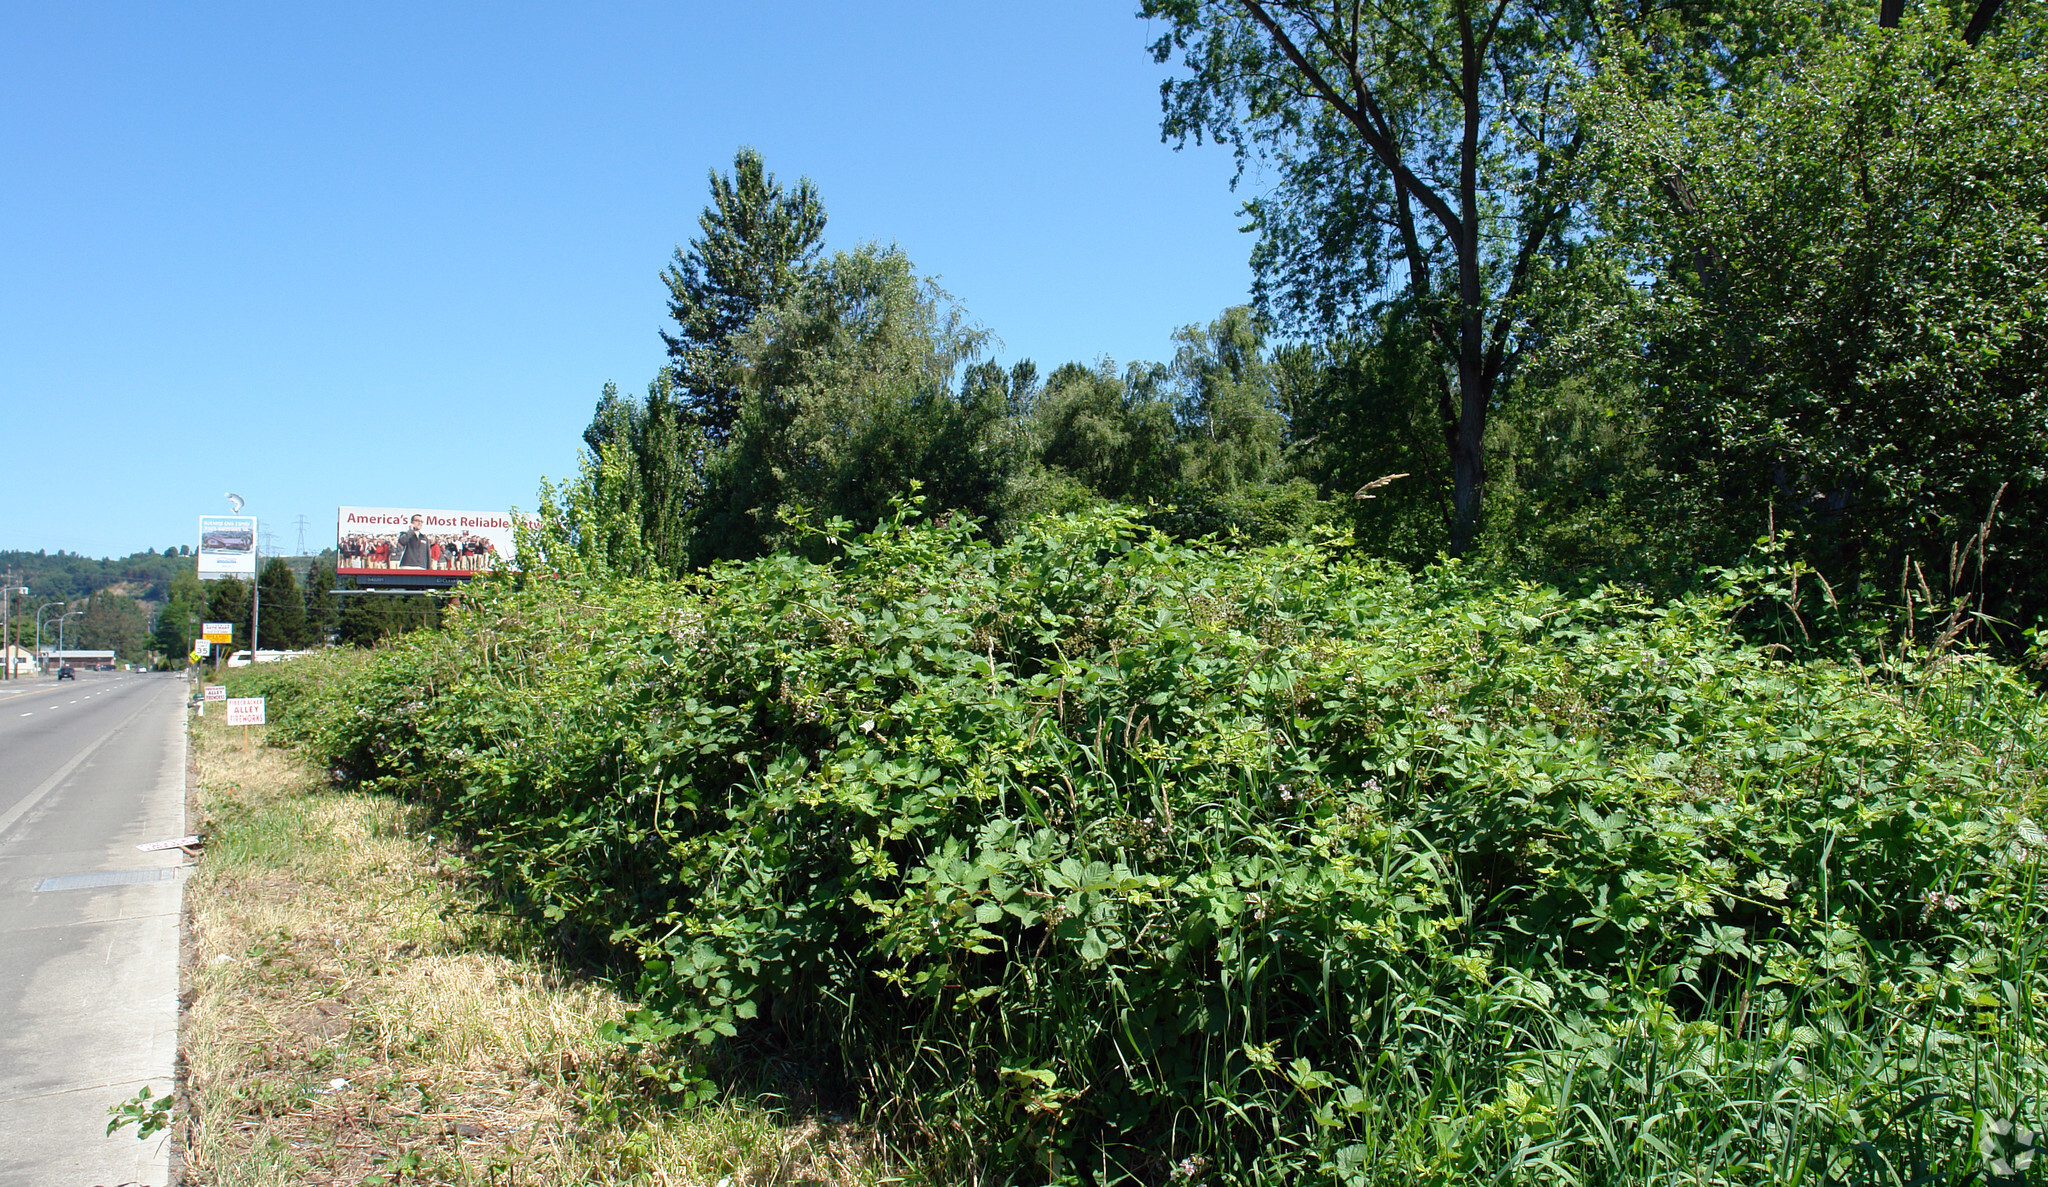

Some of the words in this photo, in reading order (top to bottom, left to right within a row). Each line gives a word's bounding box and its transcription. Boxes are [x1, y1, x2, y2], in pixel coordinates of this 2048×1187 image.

[347, 511, 408, 525] America's
[426, 515, 457, 527] Most
[460, 516, 509, 529] Reliable
[233, 705, 259, 714] ALLEY
[230, 714, 263, 723] FIREWORKS
